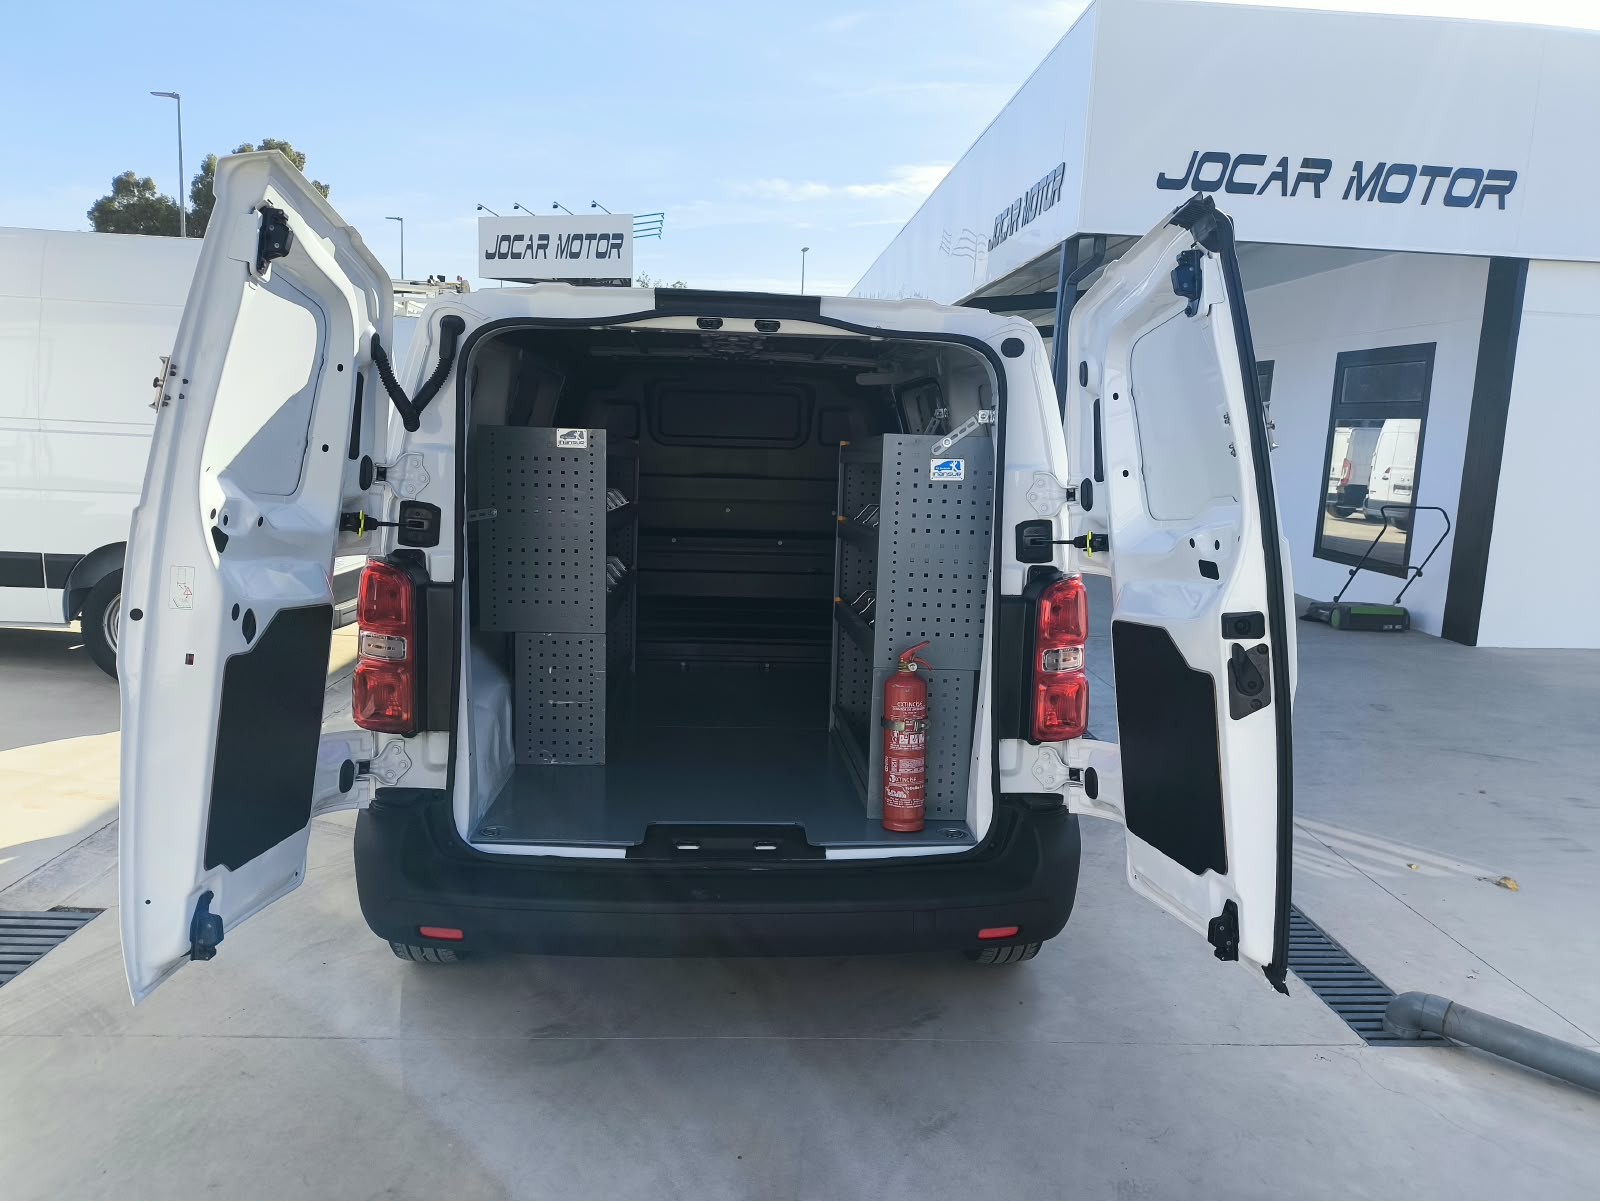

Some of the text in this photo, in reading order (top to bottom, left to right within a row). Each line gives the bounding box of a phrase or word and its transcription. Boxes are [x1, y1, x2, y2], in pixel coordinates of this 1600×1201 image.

[987, 162, 1066, 252] JOCAR MOTOR
[1156, 150, 1518, 210] JOCAR MOTOR
[485, 232, 624, 260] JOCAR MOTOR
